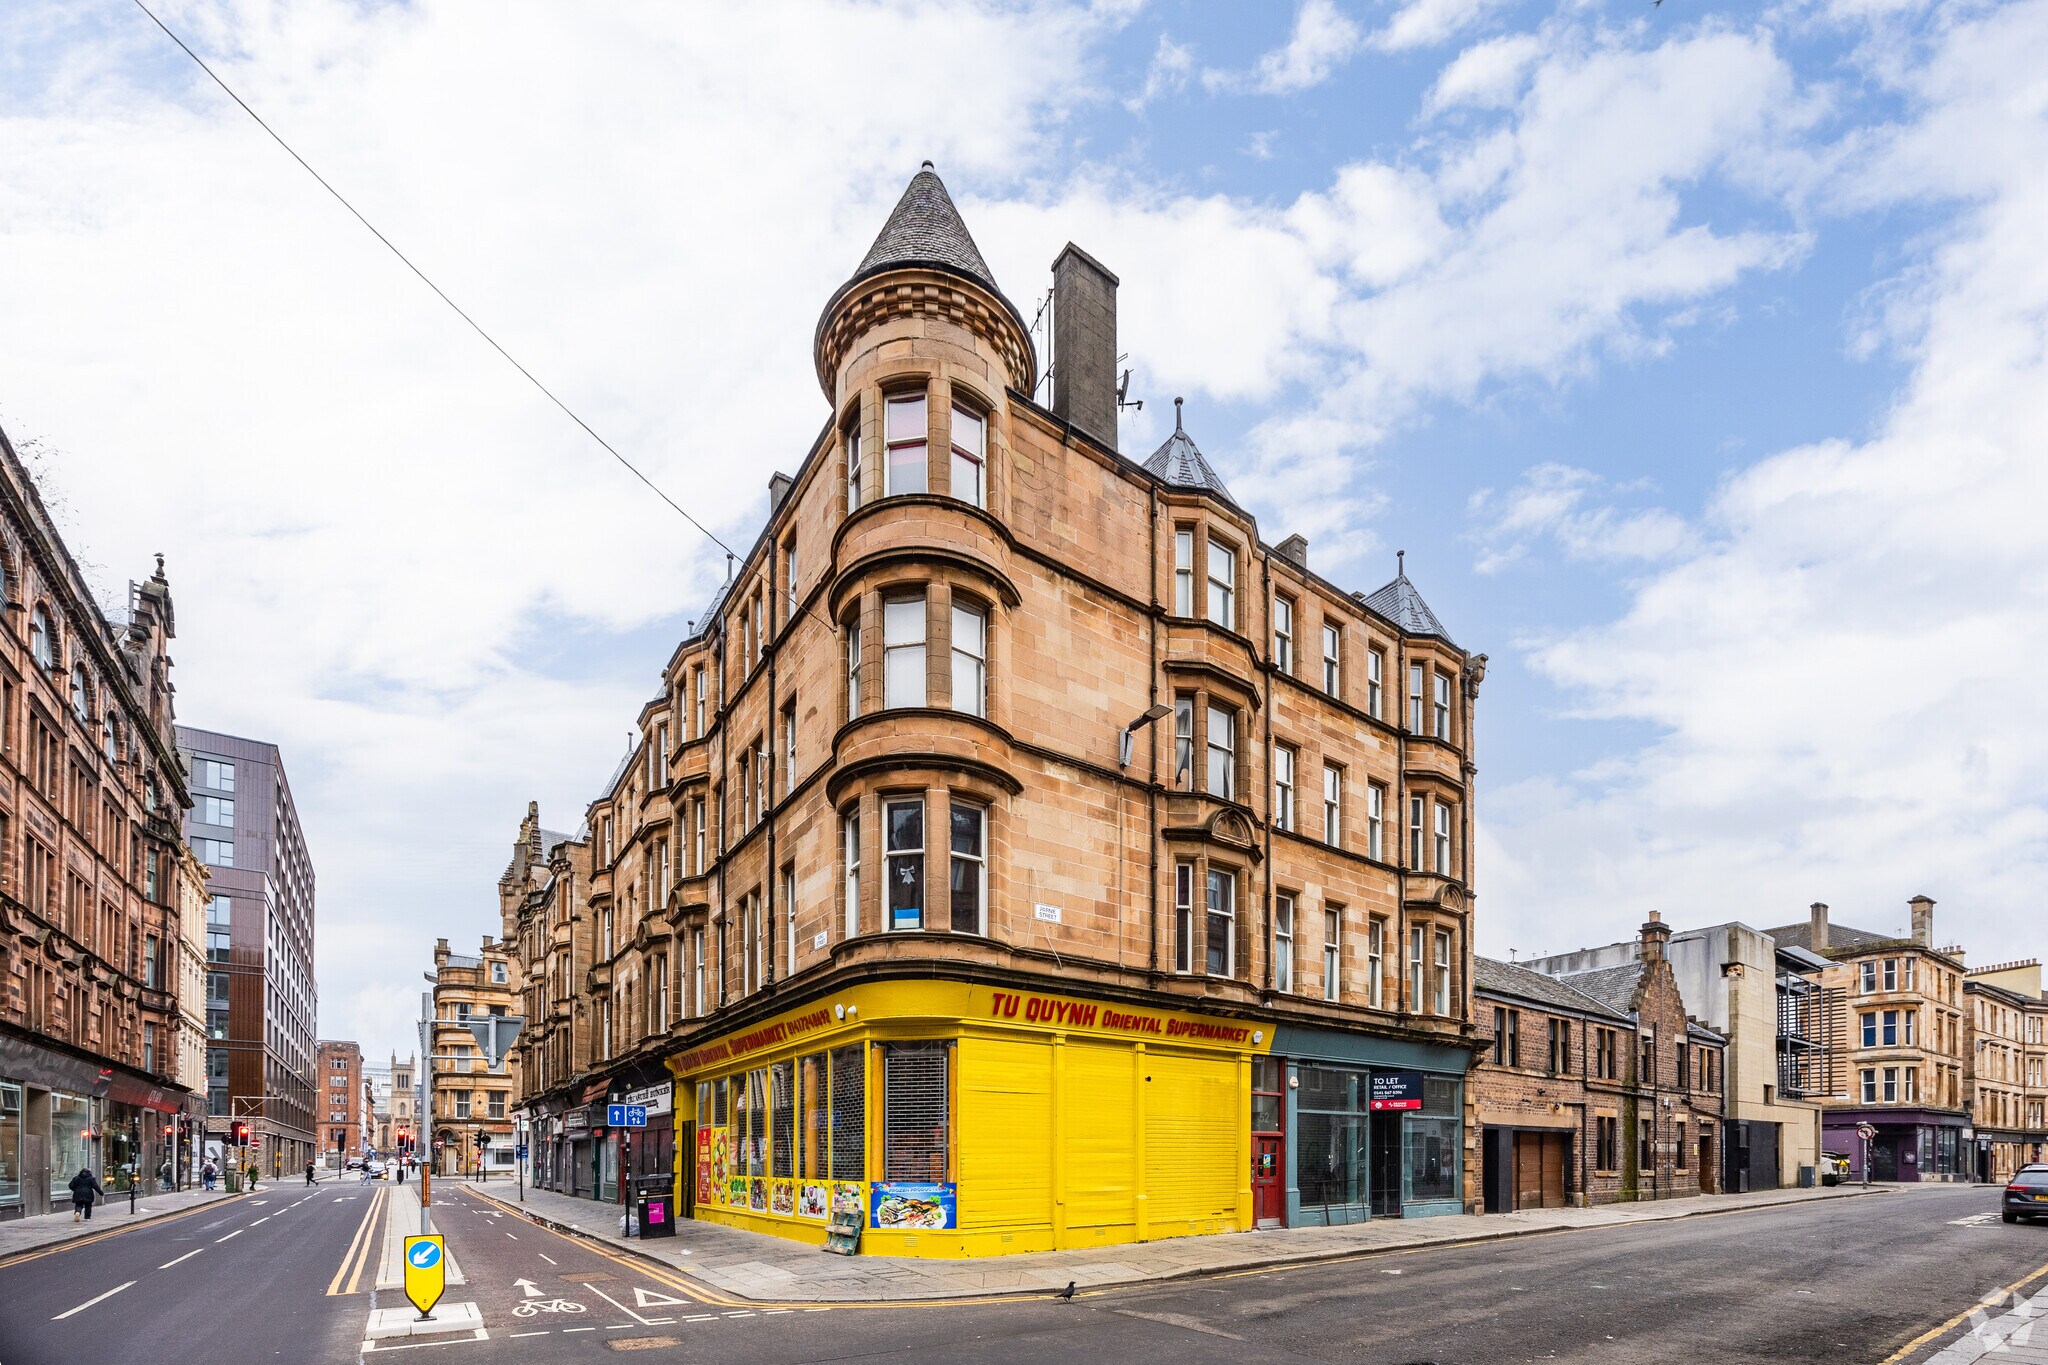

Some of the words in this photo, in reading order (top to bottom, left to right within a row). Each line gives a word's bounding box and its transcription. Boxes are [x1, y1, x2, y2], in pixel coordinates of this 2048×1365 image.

[993, 993, 1020, 1017] TU
[1026, 998, 1098, 1026] QUYNH
[1260, 1112, 1270, 1123] 52
